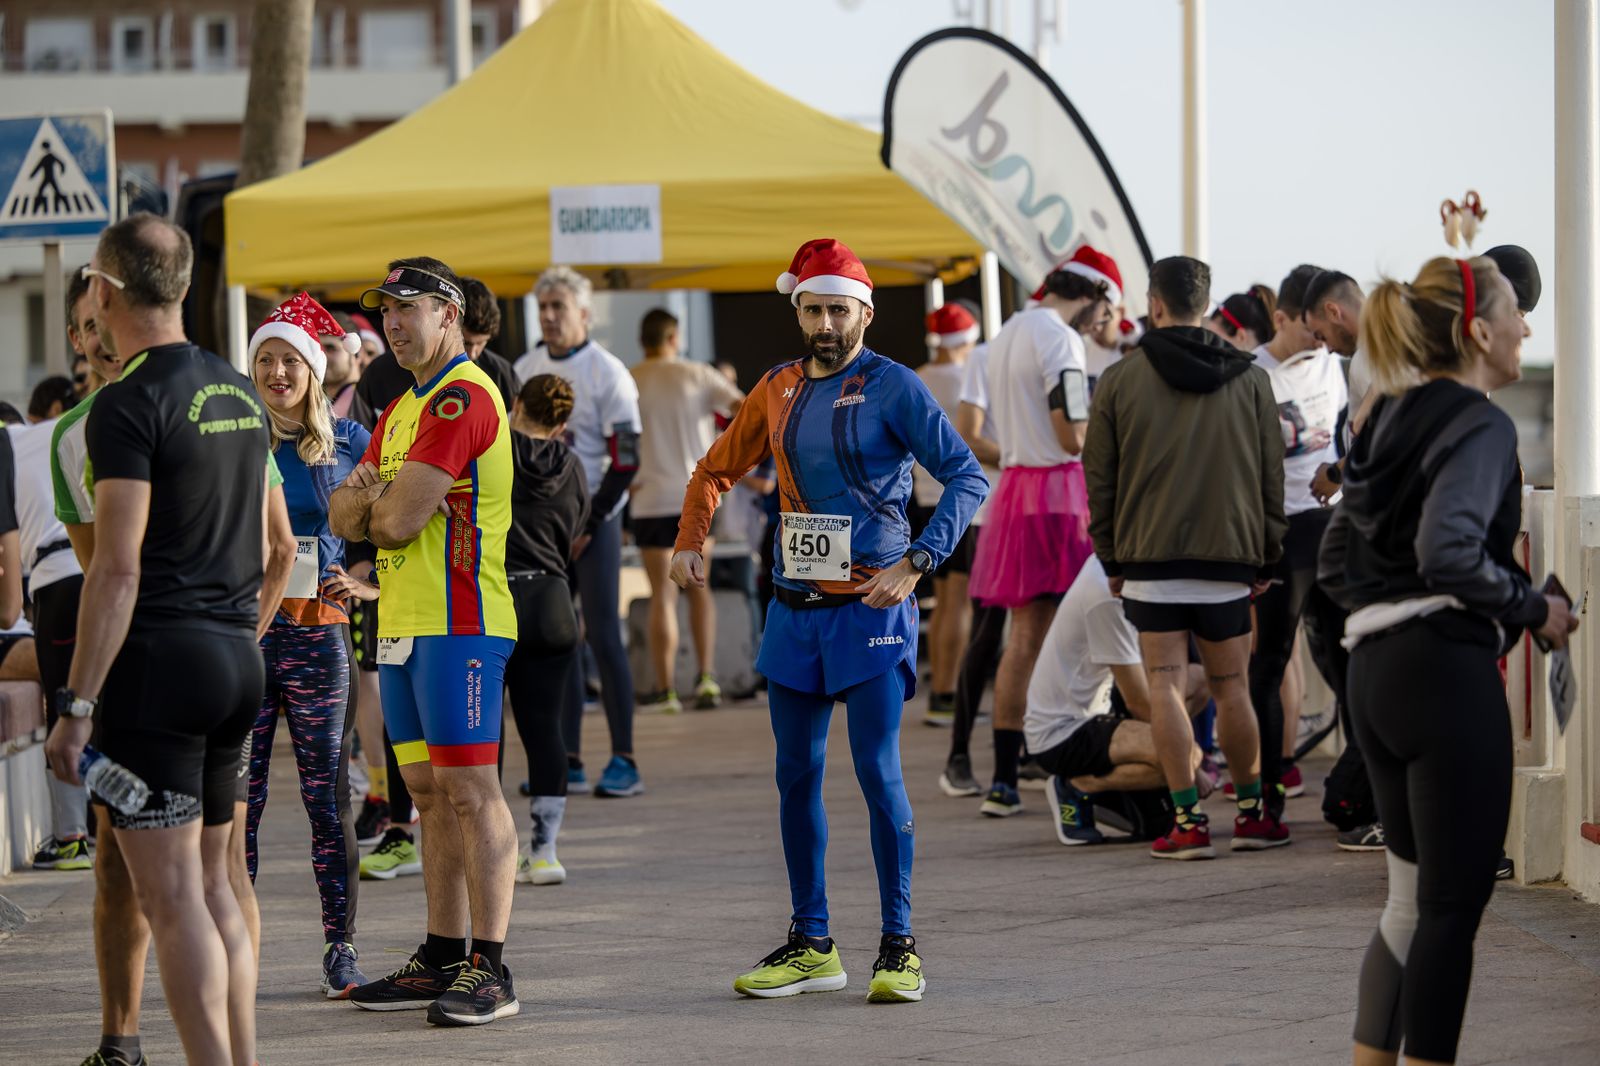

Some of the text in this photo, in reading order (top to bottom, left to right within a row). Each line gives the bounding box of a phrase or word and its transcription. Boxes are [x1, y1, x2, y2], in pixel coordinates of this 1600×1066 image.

[558, 206, 652, 234] GUARDARROPA
[199, 416, 263, 435] PUERTO REAL
[805, 523, 816, 531] DE
[454, 539, 462, 568] REAL
[788, 532, 831, 557] 450
[466, 671, 474, 708] TRIATLÓN
